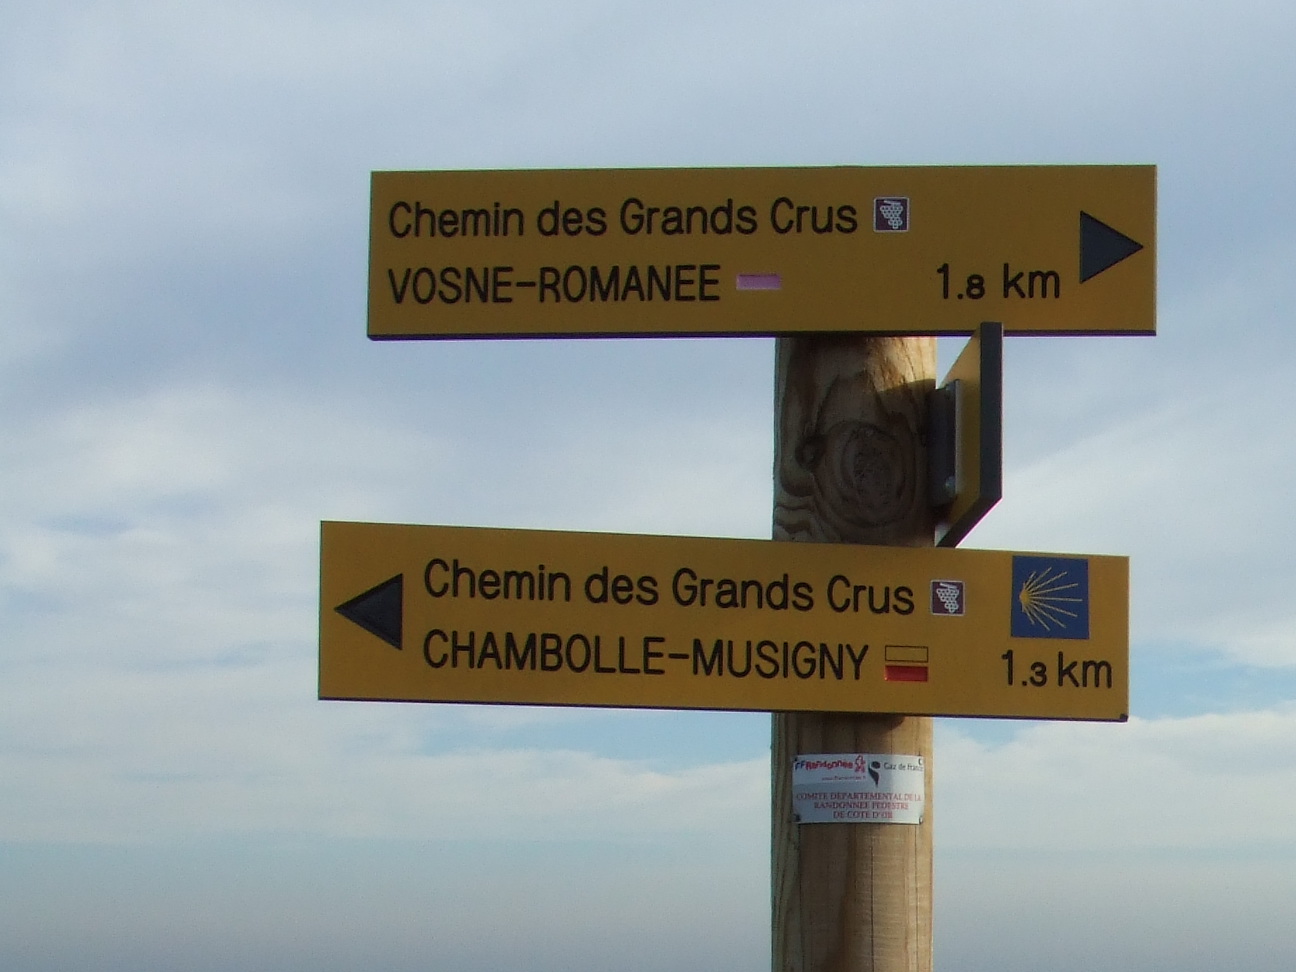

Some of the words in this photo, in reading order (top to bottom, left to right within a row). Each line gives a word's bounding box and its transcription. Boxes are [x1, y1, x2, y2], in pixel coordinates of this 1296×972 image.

[388, 200, 524, 238] Chemin
[537, 200, 607, 236] des
[620, 198, 758, 236] Grands
[770, 196, 858, 235] Crus
[388, 264, 721, 304] VOSNE-ROMANEE
[936, 262, 986, 300] 1.8
[1002, 262, 1060, 299] km
[423, 558, 572, 602] Chemin
[584, 565, 659, 605] des
[671, 567, 815, 612] Grands
[827, 574, 915, 615] Crus
[423, 628, 869, 681] CHAMBOLLE-MUSIGNY
[1001, 649, 1048, 688] 1.3
[1057, 650, 1113, 689] km
